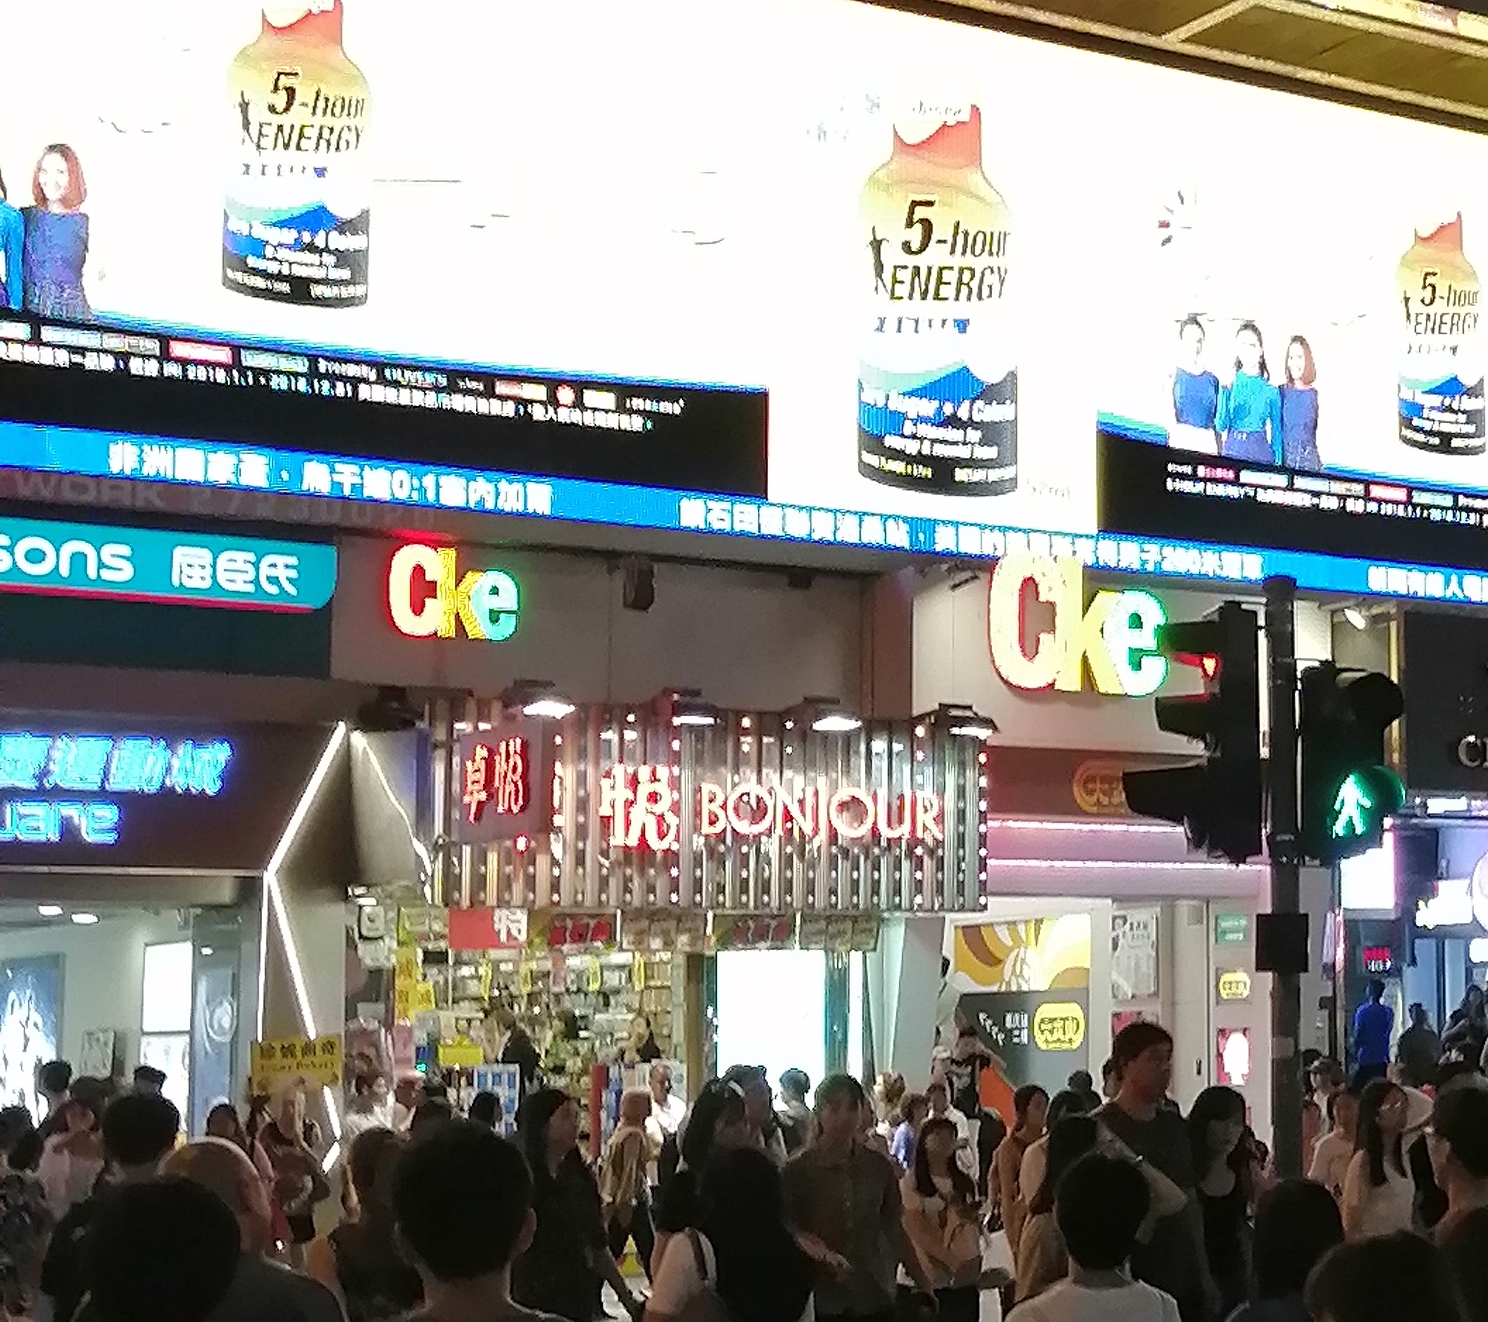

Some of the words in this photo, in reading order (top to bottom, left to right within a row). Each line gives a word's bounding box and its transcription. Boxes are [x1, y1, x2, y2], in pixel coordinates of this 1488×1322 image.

[256, 121, 365, 154] ENERGY
[889, 264, 1009, 304] ENERGY
[172, 545, 300, 597] 屈臣氏
[700, 780, 945, 843] BONJOUR
